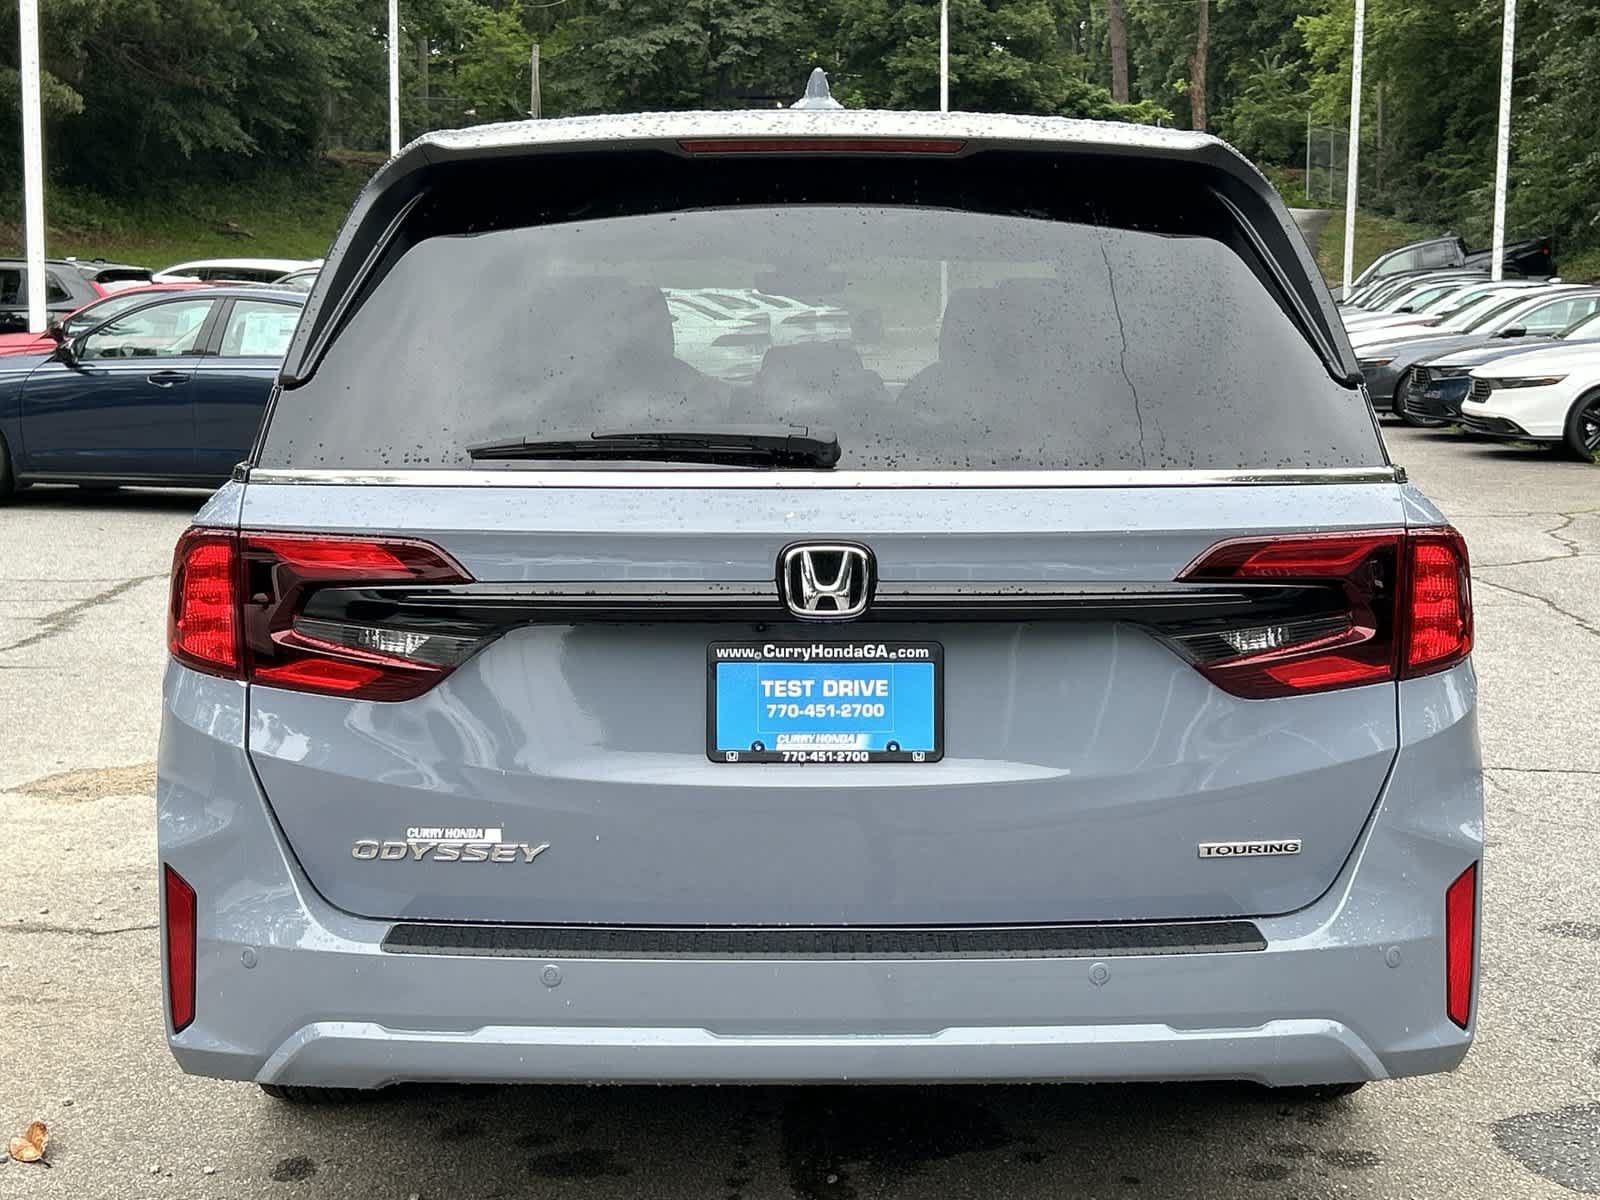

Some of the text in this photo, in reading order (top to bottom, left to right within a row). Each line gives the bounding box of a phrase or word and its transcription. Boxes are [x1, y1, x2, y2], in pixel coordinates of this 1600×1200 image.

[761, 679, 888, 697] TEST DRIVE
[766, 703, 885, 718] 770-451-2700
[776, 734, 855, 745] CURRY HONDA
[782, 751, 869, 762] 770-451-2700
[407, 827, 484, 839] CURRY HONDA
[352, 840, 550, 863] ODYSSEY
[1202, 842, 1299, 856] TOURING
